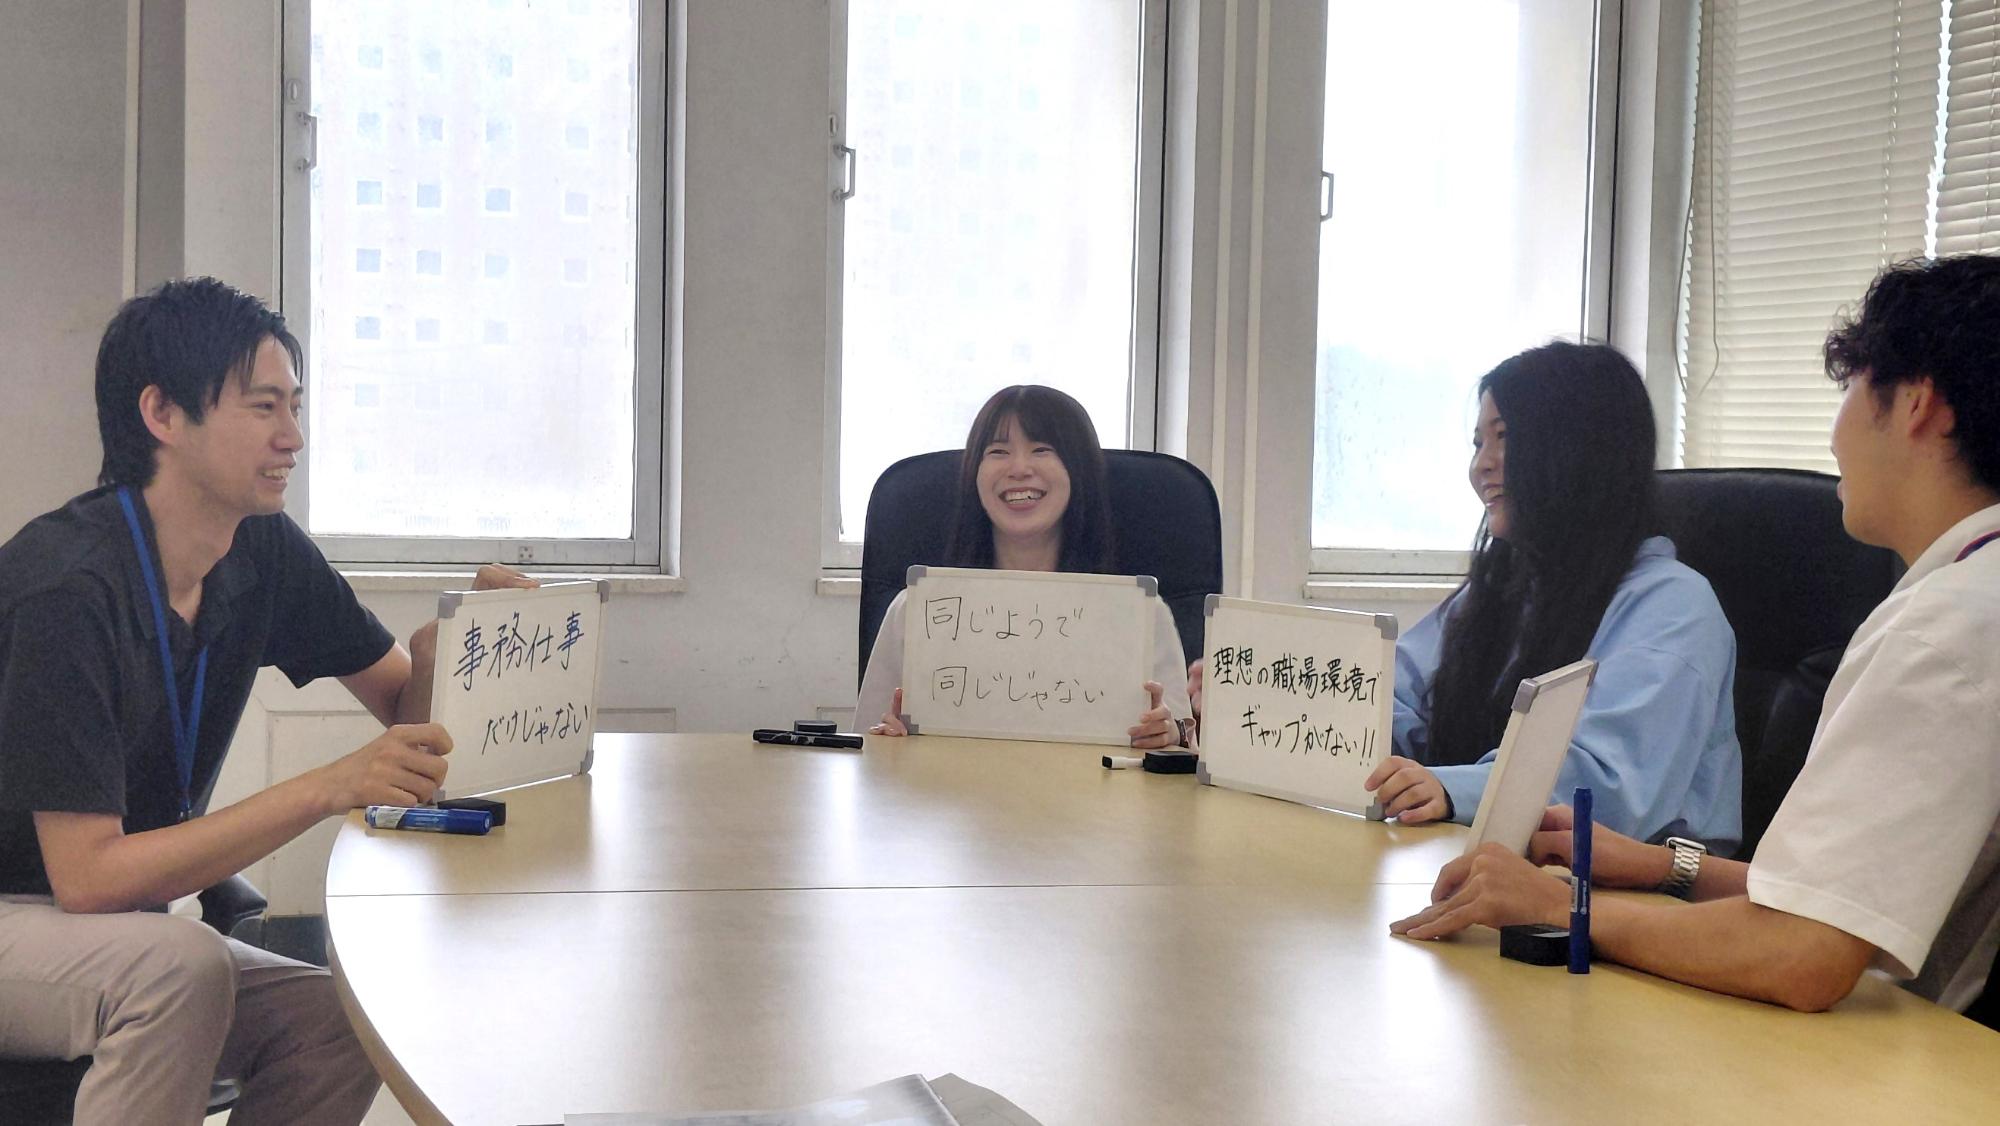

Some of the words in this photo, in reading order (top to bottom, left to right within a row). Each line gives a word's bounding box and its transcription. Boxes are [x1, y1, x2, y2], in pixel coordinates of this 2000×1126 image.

[925, 596, 1084, 641] 同じようで
[453, 611, 585, 691] 事務仕事
[1213, 645, 1383, 705] 理想の職場環境で
[932, 666, 1104, 711] 同じじゃない
[482, 702, 589, 755] だけじゃない
